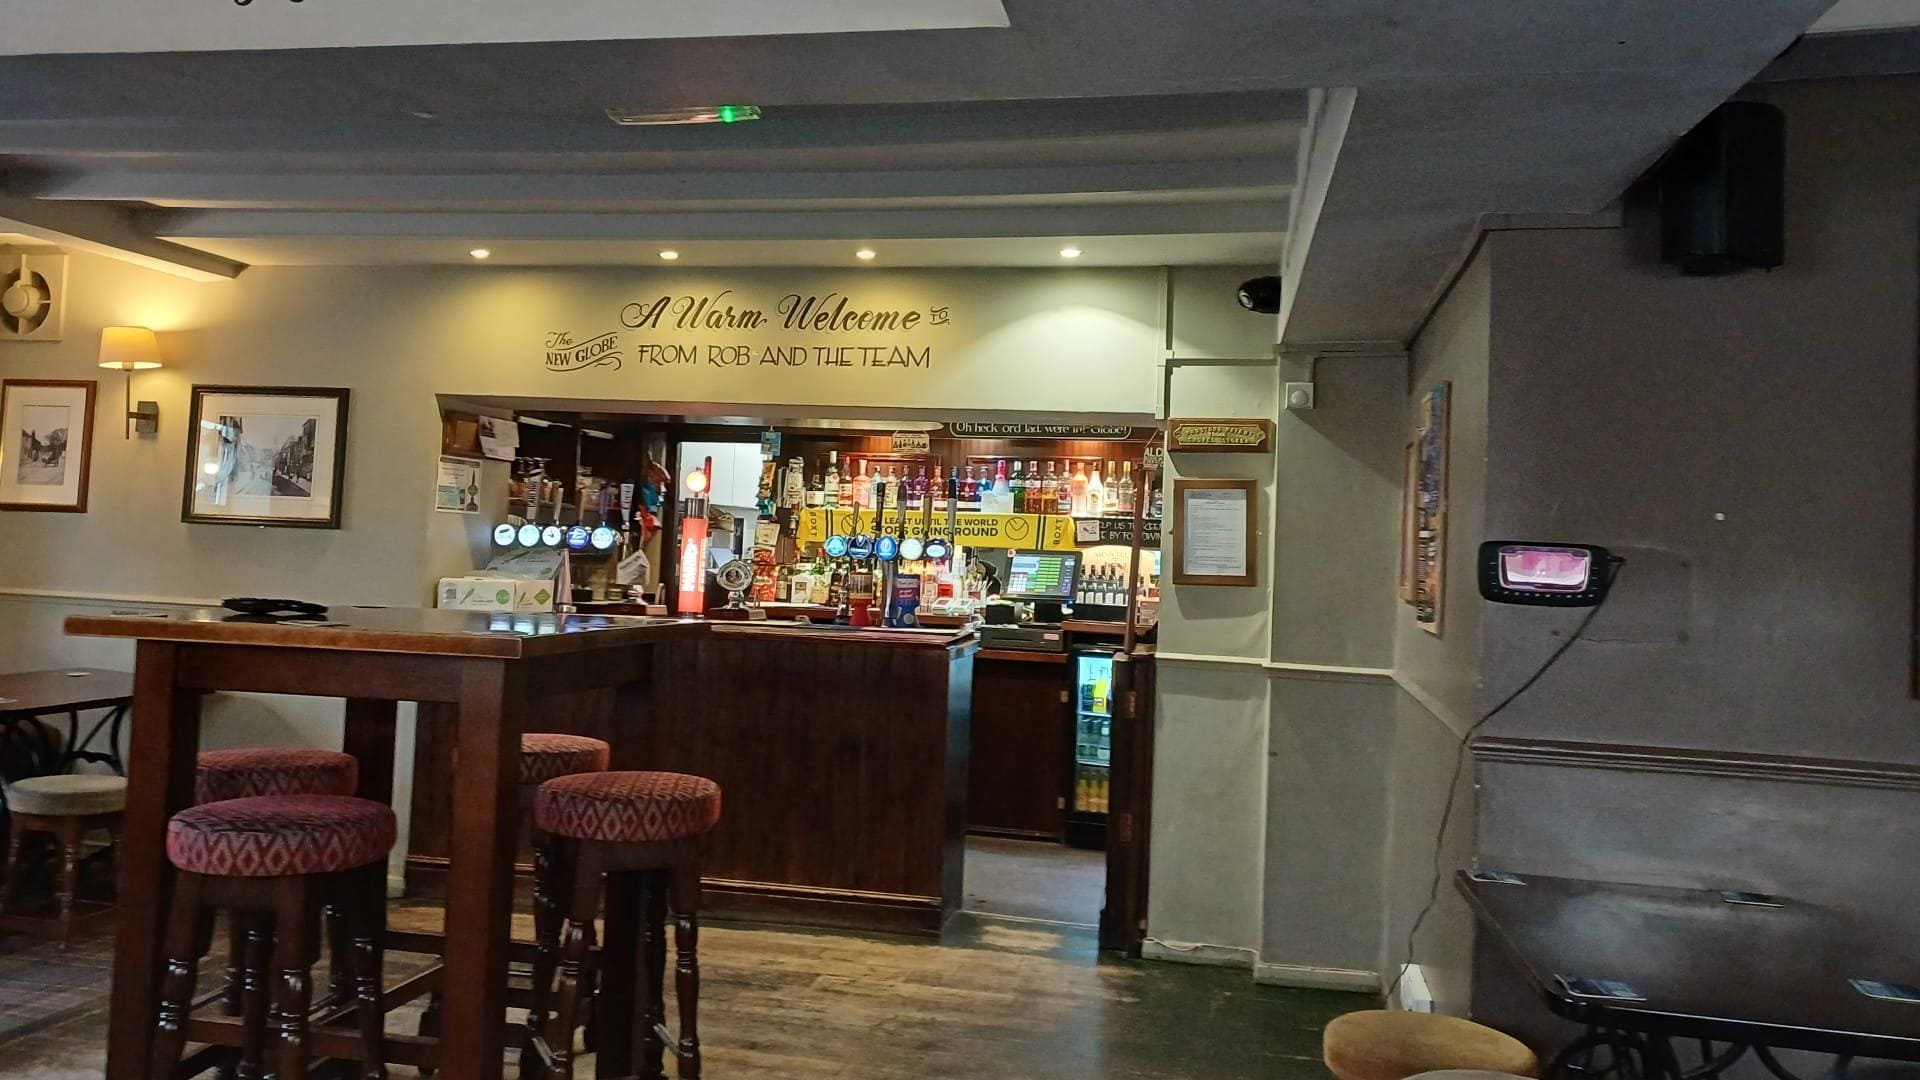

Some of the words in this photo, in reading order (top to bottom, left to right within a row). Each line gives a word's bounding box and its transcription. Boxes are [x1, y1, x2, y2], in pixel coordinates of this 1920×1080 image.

[620, 296, 671, 329] A
[672, 290, 767, 329] Warm
[777, 293, 921, 331] Welcome
[930, 309, 948, 322] TO
[545, 331, 573, 348] The
[545, 351, 572, 366] NEW
[575, 336, 618, 362] GLOBE
[638, 344, 697, 366] FROM
[708, 345, 751, 367] ROB
[760, 345, 808, 367] AND
[813, 346, 855, 367] THE
[857, 345, 931, 368] TEAM
[884, 517, 914, 525] LEAT
[943, 518, 964, 526] TE
[964, 518, 999, 527] WORLD
[955, 526, 999, 537] ROUND
